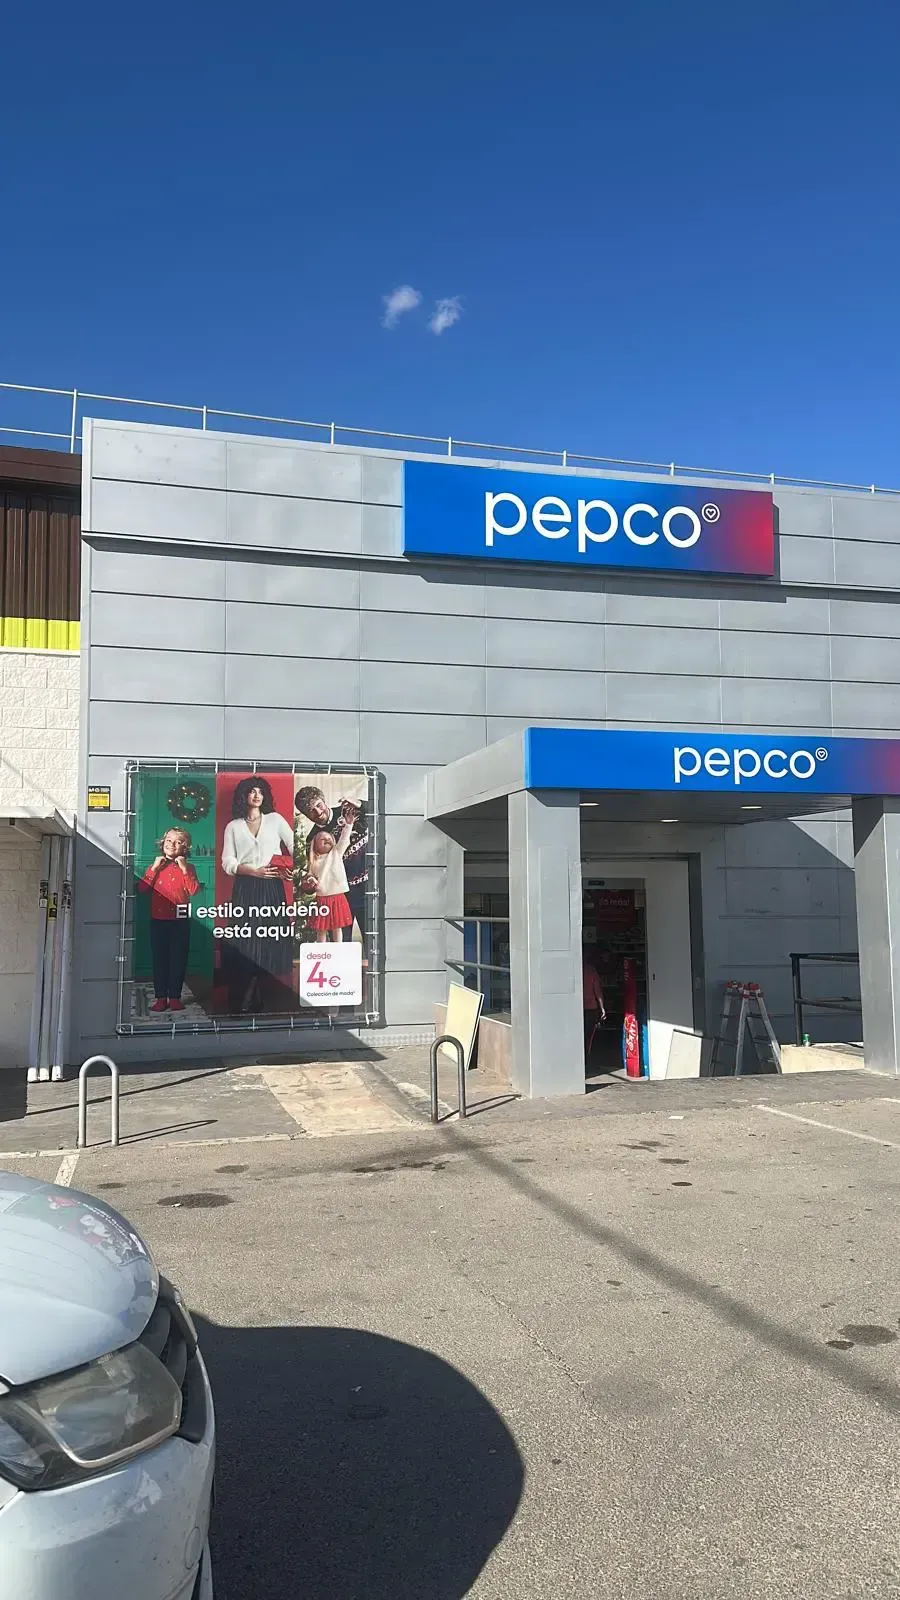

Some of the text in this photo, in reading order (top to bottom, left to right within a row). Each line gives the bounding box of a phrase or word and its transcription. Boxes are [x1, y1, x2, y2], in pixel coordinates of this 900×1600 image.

[485, 491, 702, 553] pepco
[673, 746, 816, 785] pepco
[175, 901, 330, 919] El estilo navideño
[212, 922, 251, 939] está
[306, 952, 332, 960] desde
